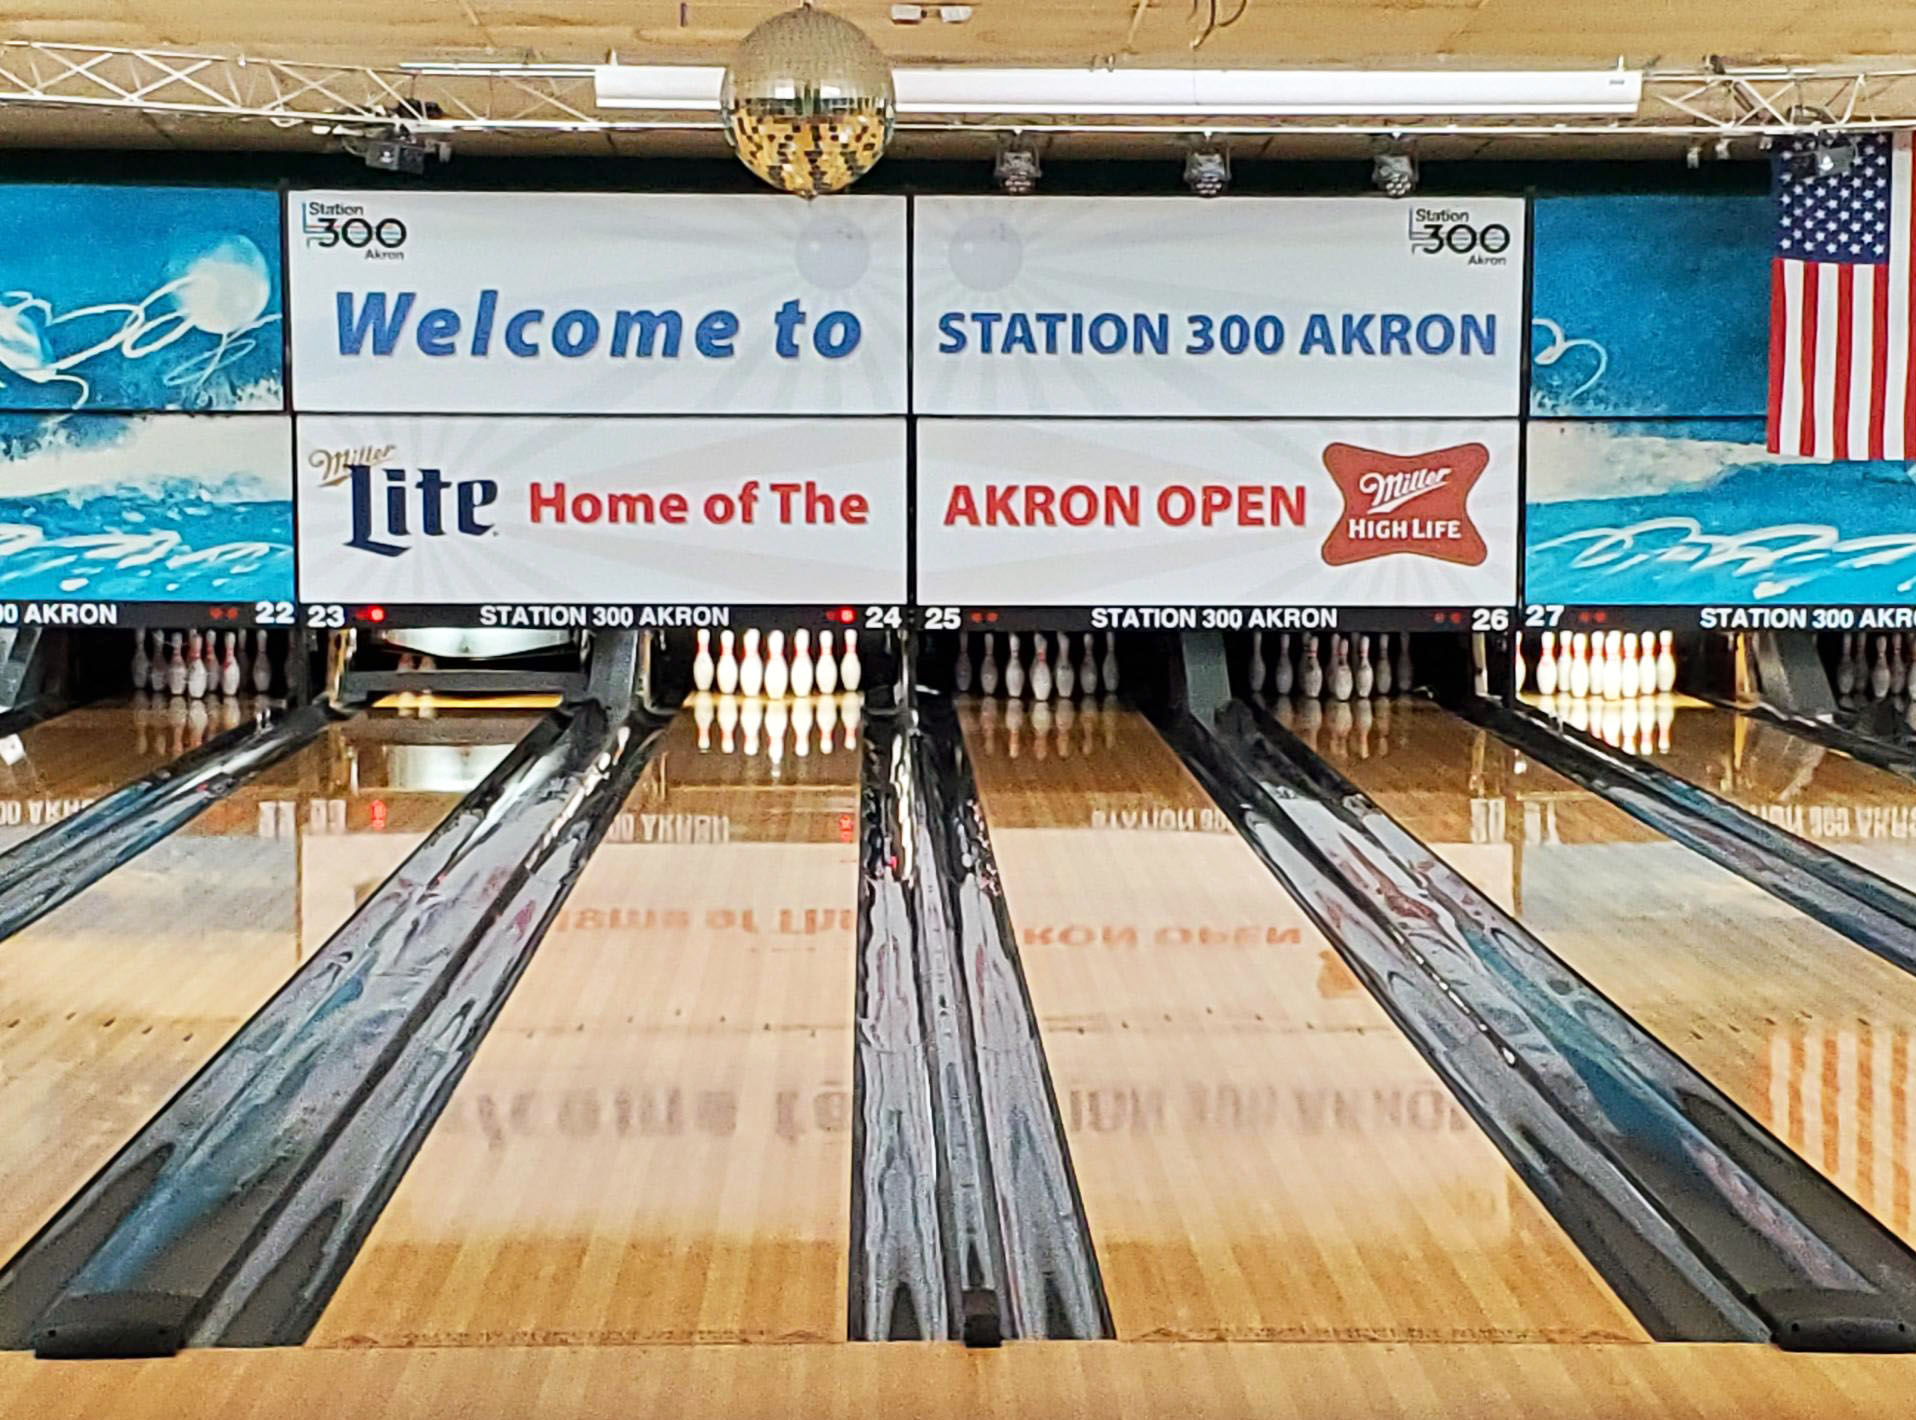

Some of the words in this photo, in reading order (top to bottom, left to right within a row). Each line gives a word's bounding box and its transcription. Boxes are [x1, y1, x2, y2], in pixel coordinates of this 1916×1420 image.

[308, 201, 364, 216] Station
[1415, 208, 1470, 223] Station
[317, 217, 408, 249] 300
[1422, 223, 1512, 255] 300
[364, 249, 405, 261] Akron
[1467, 254, 1507, 267] Akron
[336, 288, 739, 359] Welcome
[774, 299, 861, 359] to
[939, 311, 1169, 354] STATION
[1189, 313, 1285, 355] 300
[1301, 312, 1497, 356] AKRON
[309, 445, 396, 488] Miller
[530, 483, 688, 525] Home
[703, 480, 758, 525] of
[770, 480, 869, 525] The
[1359, 467, 1453, 515] Miller
[342, 464, 498, 558] Lite
[943, 484, 1139, 527] AKRON
[1157, 484, 1306, 528] OPEN
[1348, 518, 1408, 539] HIGH
[1412, 518, 1462, 539] LIFE
[23, 603, 117, 625] AKRON
[255, 601, 295, 625] 22
[307, 604, 346, 628] 23
[479, 606, 587, 626] STATION
[592, 606, 634, 628] 300
[638, 606, 730, 627] AKRON
[864, 606, 902, 629] 24
[924, 607, 961, 630] 25
[1091, 607, 1197, 629] STATION
[1201, 608, 1243, 629] 300
[1247, 607, 1338, 629] AKRON
[1471, 608, 1509, 631] 26
[1525, 604, 1565, 629] 27
[1699, 607, 1807, 629] STATION
[1811, 608, 1855, 629] 300
[1858, 607, 1916, 629] AKR
